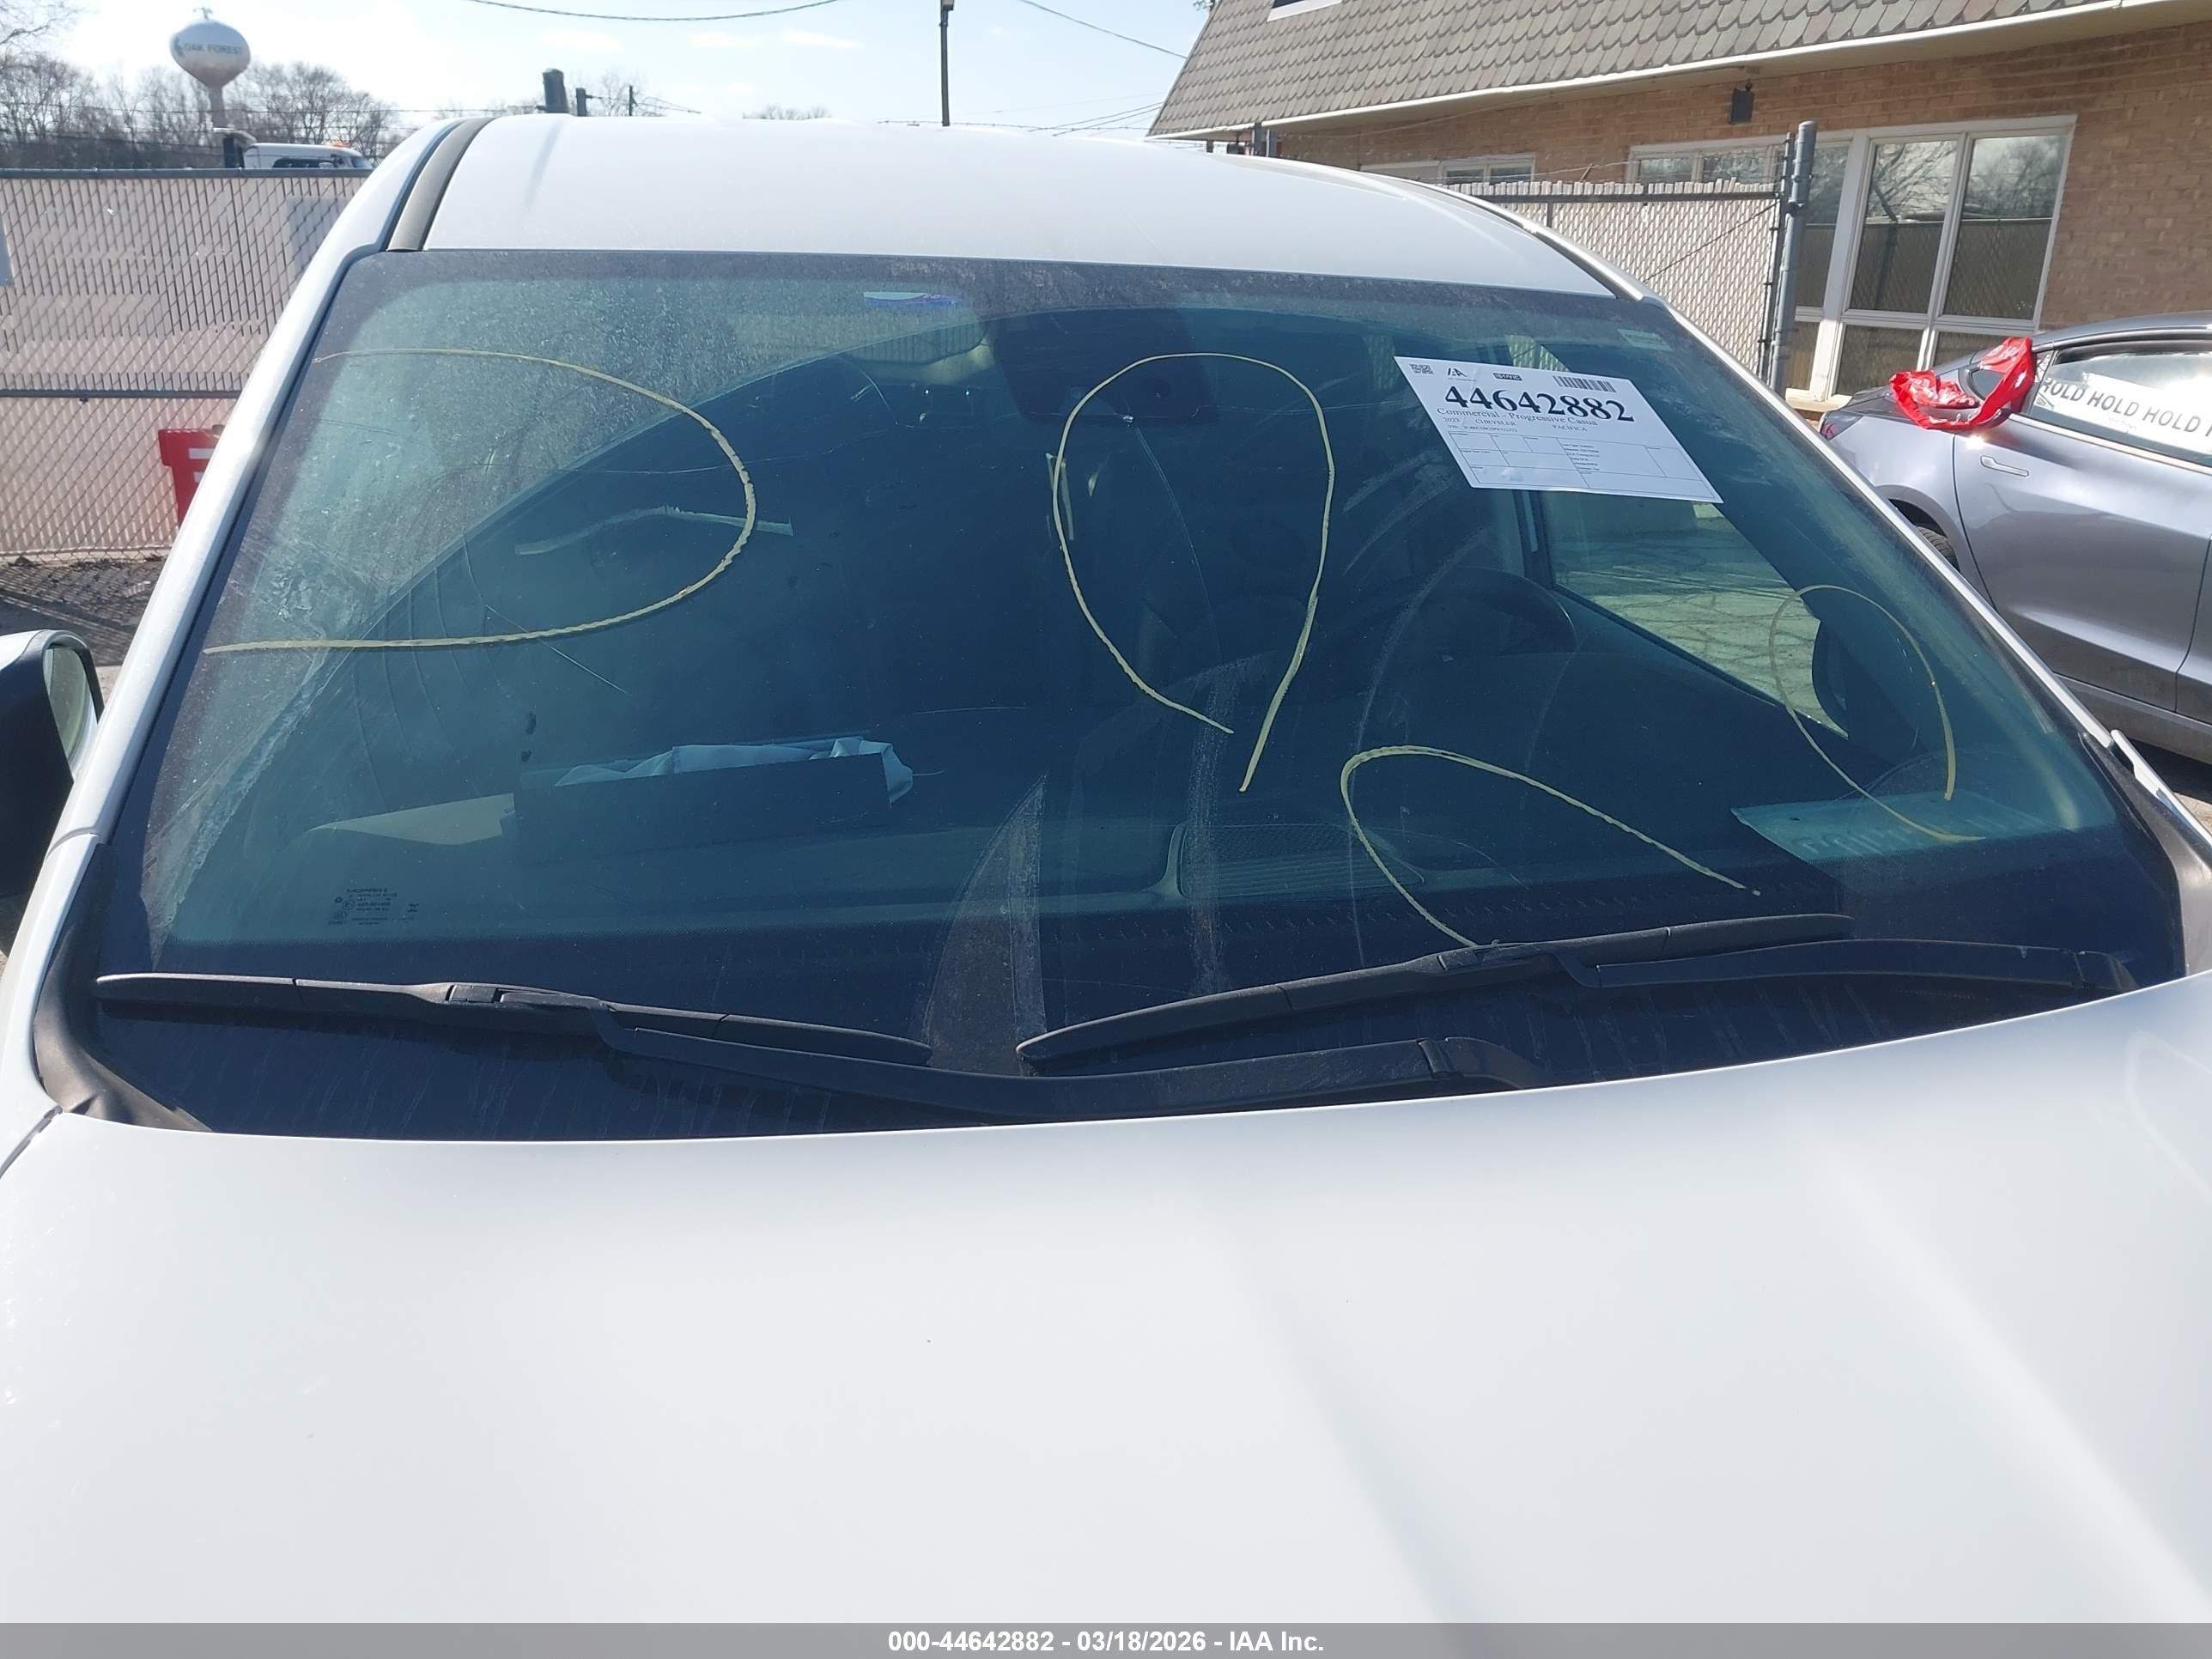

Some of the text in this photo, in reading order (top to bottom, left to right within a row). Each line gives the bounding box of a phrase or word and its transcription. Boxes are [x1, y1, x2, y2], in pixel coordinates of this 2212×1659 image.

[183, 43, 241, 55] OAK FOREST
[1444, 386, 1635, 422] 44642882
[2042, 377, 2086, 402] HOLD
[2087, 390, 2140, 417] HOLD
[2142, 406, 2202, 433] HOLD
[1437, 407, 1500, 418] Commercial
[1508, 412, 1565, 422] Progressive
[1567, 416, 1598, 426] Casua
[1475, 418, 1516, 427] CHRYSLER
